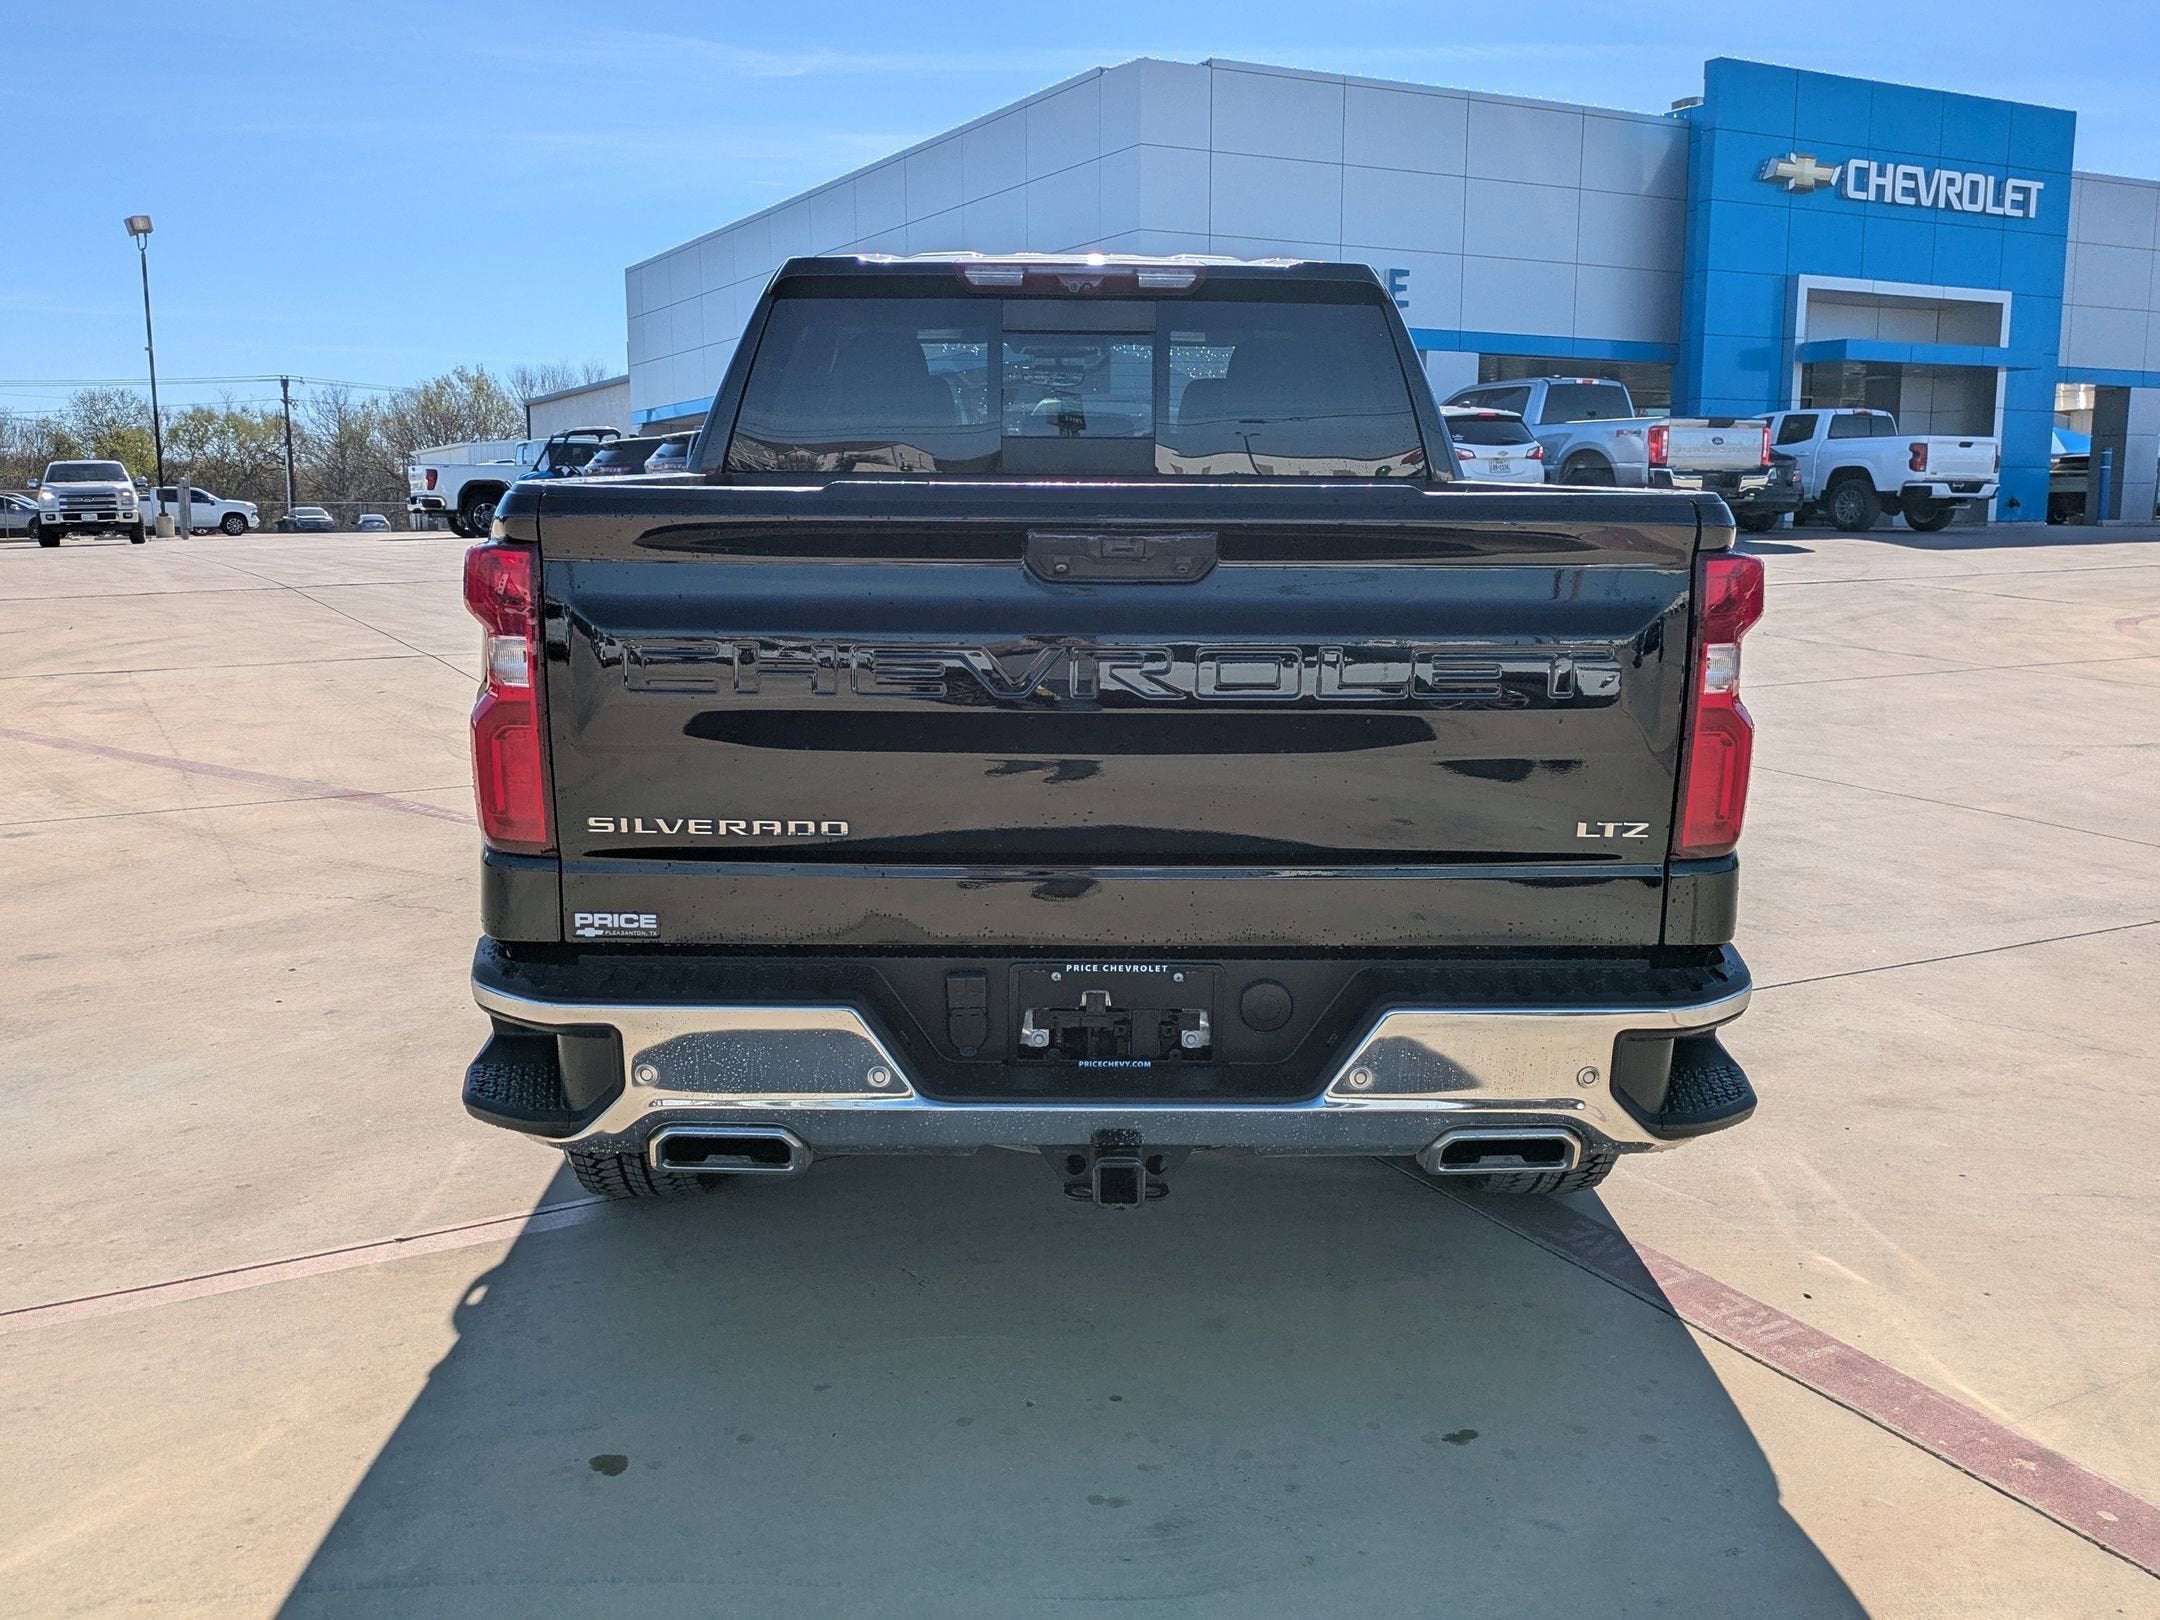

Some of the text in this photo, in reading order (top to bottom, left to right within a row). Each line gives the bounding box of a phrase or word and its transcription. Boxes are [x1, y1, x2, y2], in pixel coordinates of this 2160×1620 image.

[1846, 158, 2045, 219] CHEVROLET
[622, 639, 1617, 701] CHEVROLET
[587, 816, 849, 837] SILVERADO
[1576, 821, 1649, 839] LTZ
[574, 913, 658, 929] PRICE
[1066, 964, 1168, 973] PRICE CHEVROLET
[1078, 1060, 1151, 1068] PRICECHEVY.COM
